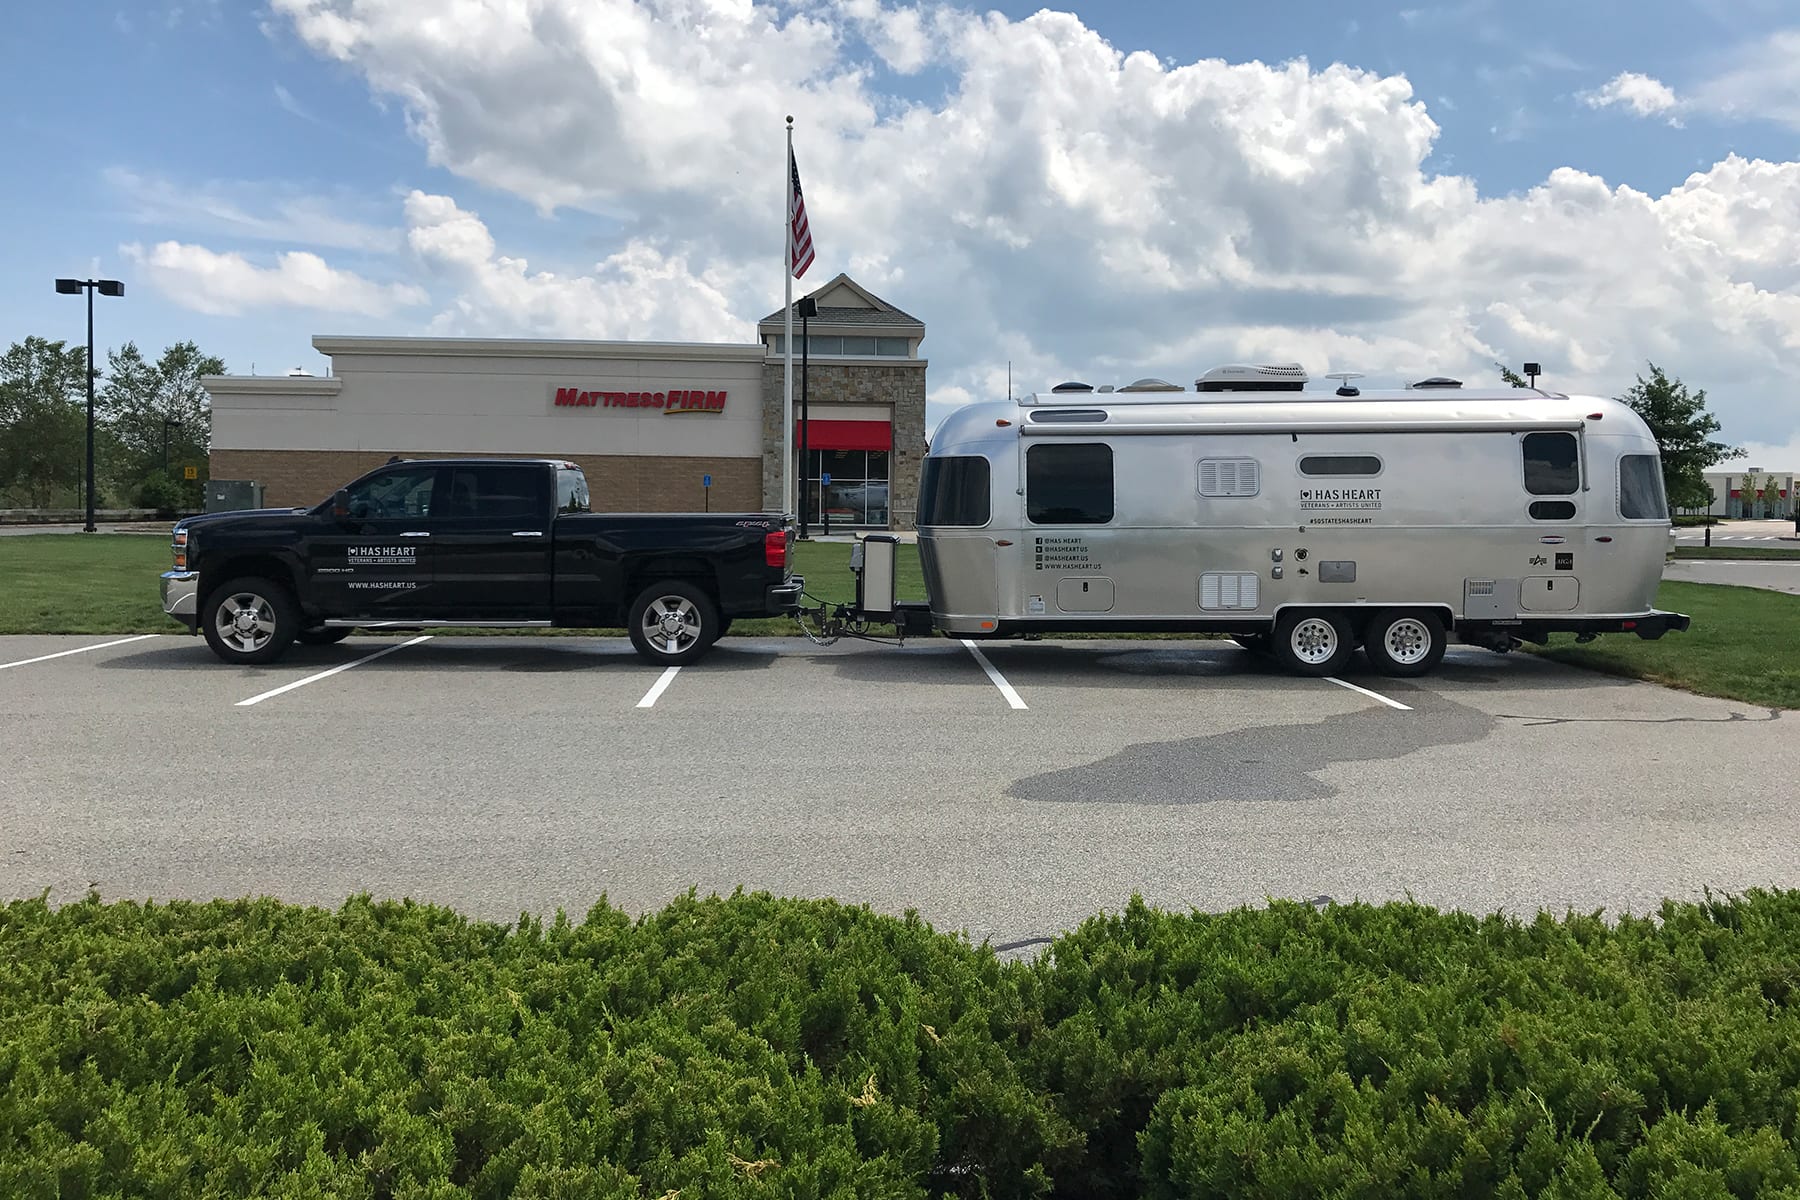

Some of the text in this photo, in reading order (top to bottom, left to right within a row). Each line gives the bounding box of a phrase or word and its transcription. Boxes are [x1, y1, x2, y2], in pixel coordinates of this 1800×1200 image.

[1315, 489, 1381, 500] HAS HEART
[360, 547, 417, 556] HAS HEART
